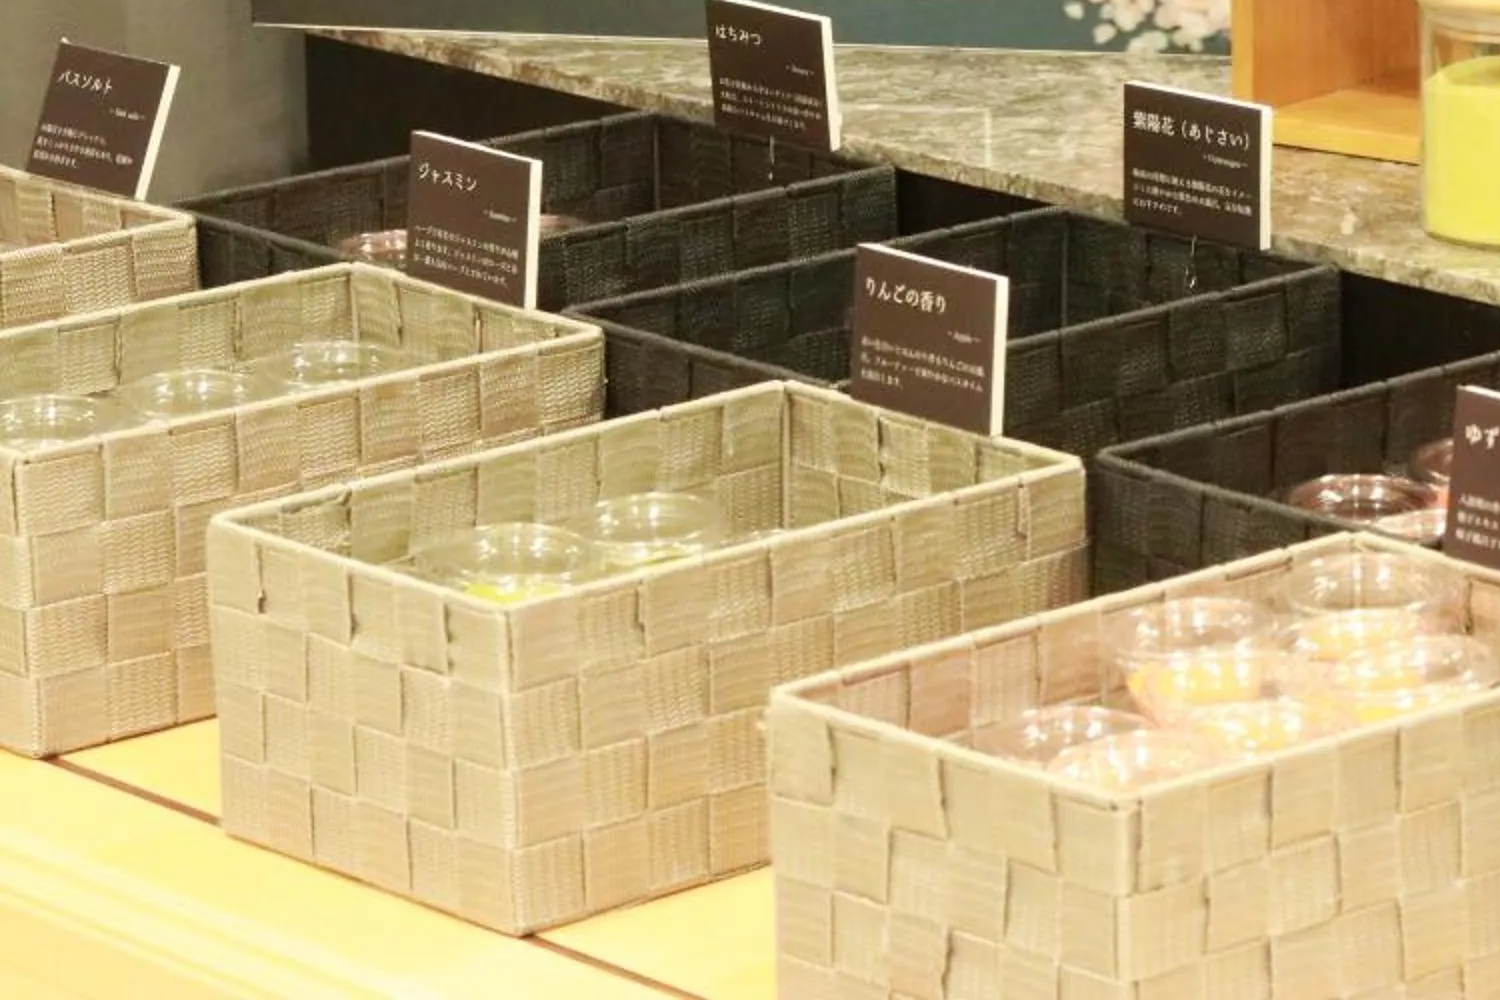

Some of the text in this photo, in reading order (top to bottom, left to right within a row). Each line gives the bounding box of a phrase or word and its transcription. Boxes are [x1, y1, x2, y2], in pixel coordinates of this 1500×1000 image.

[715, 24, 761, 46] はちみつ
[56, 69, 113, 96] バスソルト
[418, 162, 478, 192] ジャスミン
[866, 276, 947, 314] りんごの香り
[1464, 424, 1500, 449] ゆず
